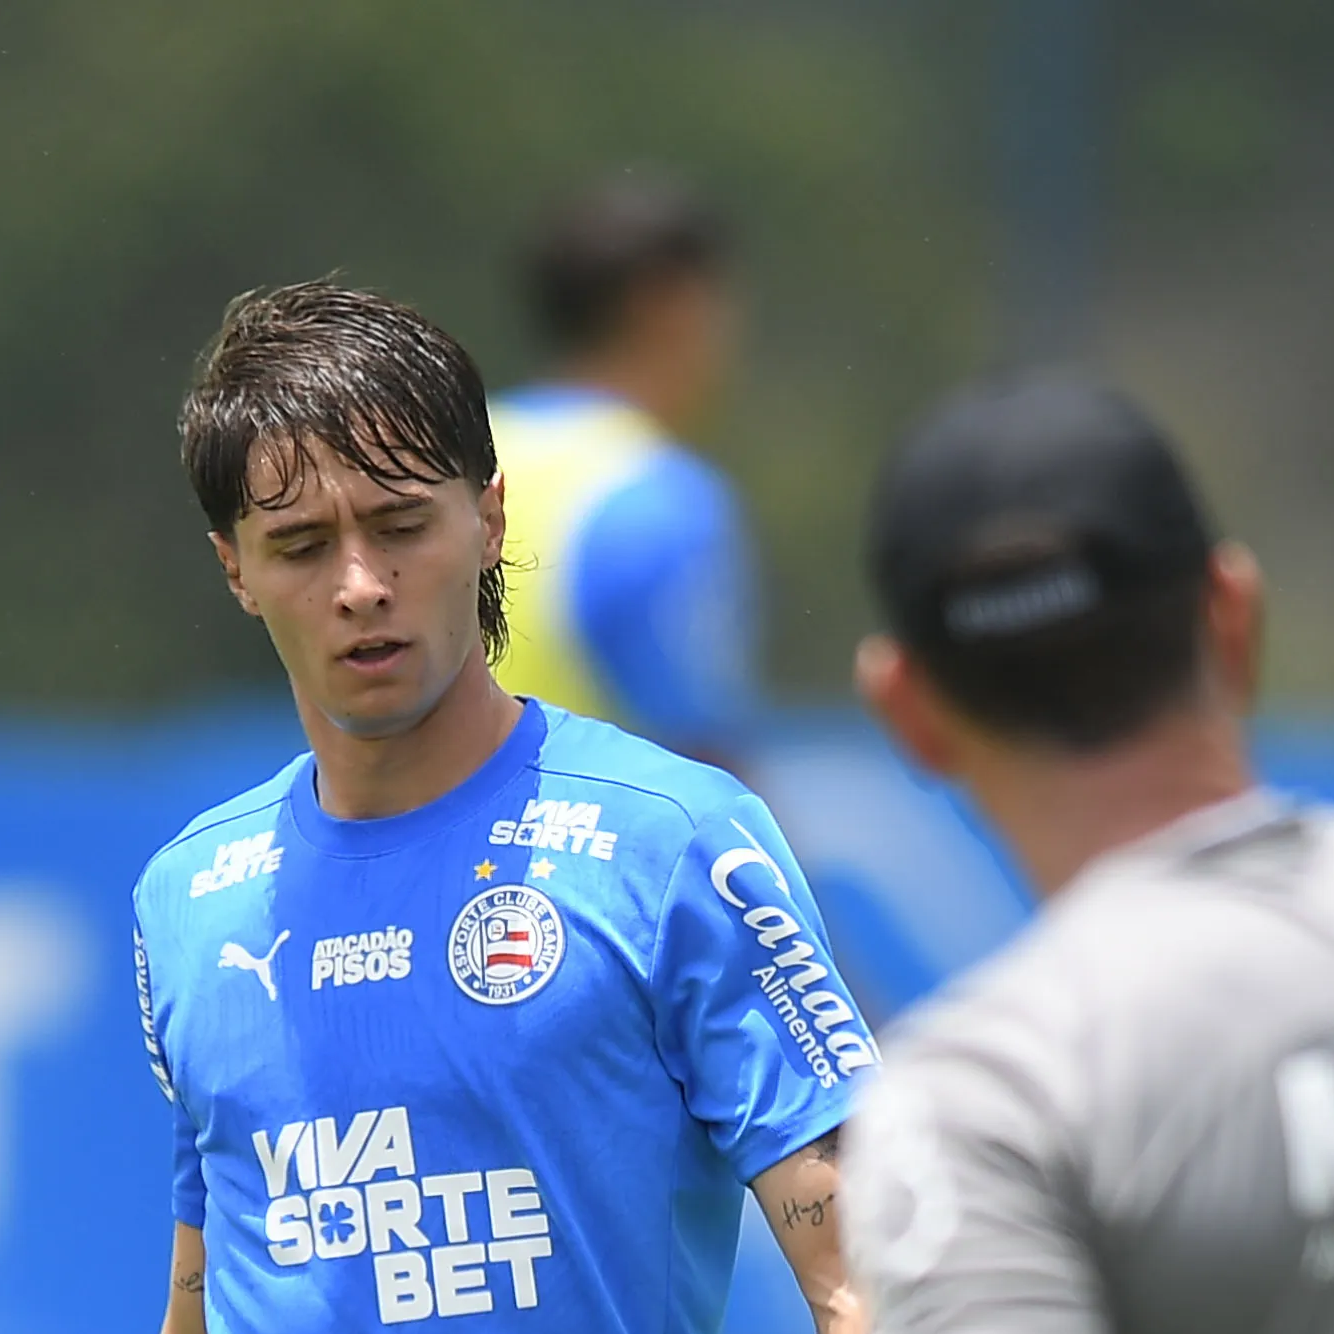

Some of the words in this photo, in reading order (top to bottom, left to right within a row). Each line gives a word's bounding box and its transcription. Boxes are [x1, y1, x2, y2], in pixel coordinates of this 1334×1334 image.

[521, 798, 602, 829] VIVA
[212, 830, 276, 868] VIVA
[488, 819, 619, 861] SORTE
[189, 846, 285, 899] SORTE
[312, 925, 413, 960] ATACADÃO
[454, 900, 492, 980] ESPORTE
[493, 892, 546, 920] CLUBE
[532, 918, 557, 972] BAHIA
[311, 948, 412, 990] PISOS
[488, 983, 517, 999] 1931
[752, 965, 839, 1089] Alimentos
[252, 1106, 416, 1199] VIVA
[265, 1168, 550, 1266] SORTE
[373, 1236, 553, 1325] BET
